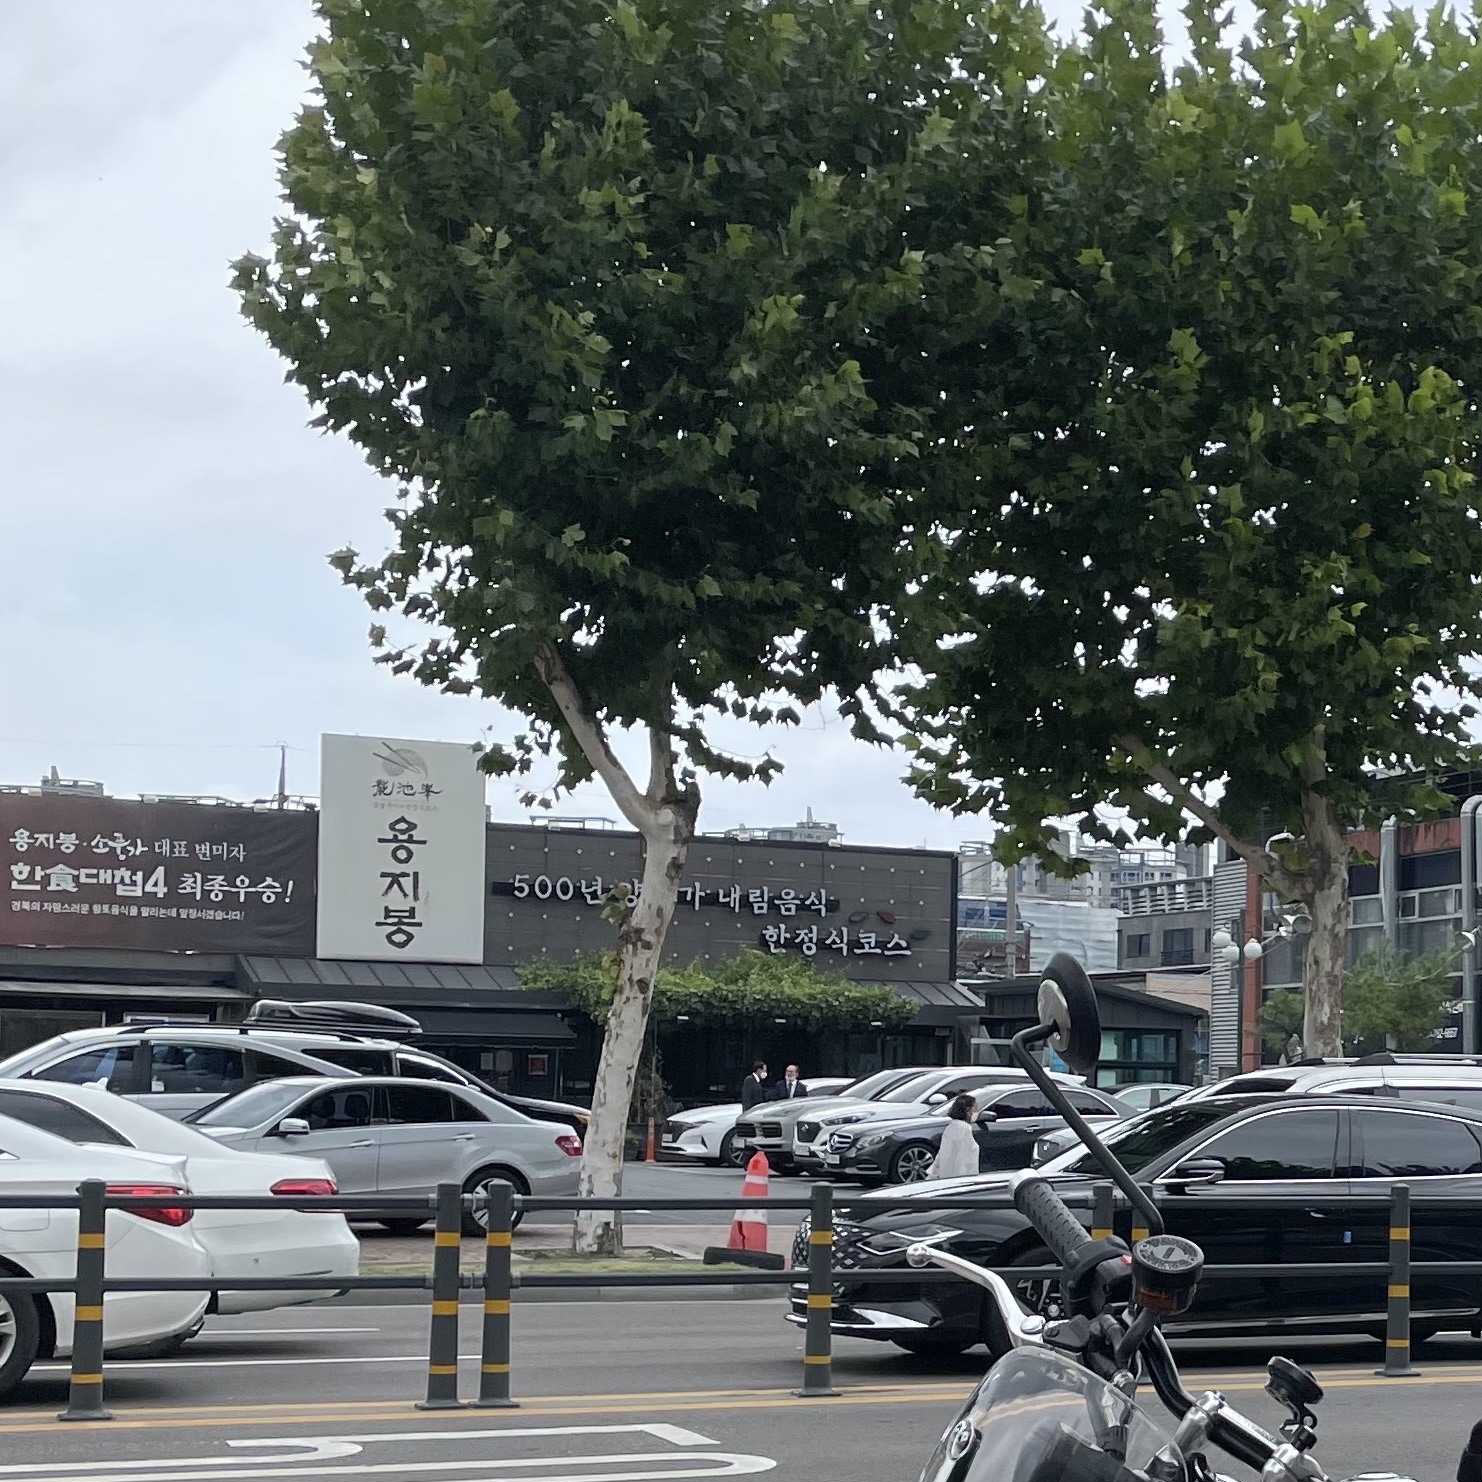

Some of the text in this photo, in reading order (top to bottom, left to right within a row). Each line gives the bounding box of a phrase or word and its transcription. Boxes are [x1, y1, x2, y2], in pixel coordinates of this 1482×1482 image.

[154, 838, 189, 858] 대표
[195, 842, 248, 863] 변미자
[177, 871, 294, 903] 최종우승!
[375, 815, 428, 949] 용지봉
[513, 874, 603, 906] 500년
[762, 923, 912, 957] 한정식코스
